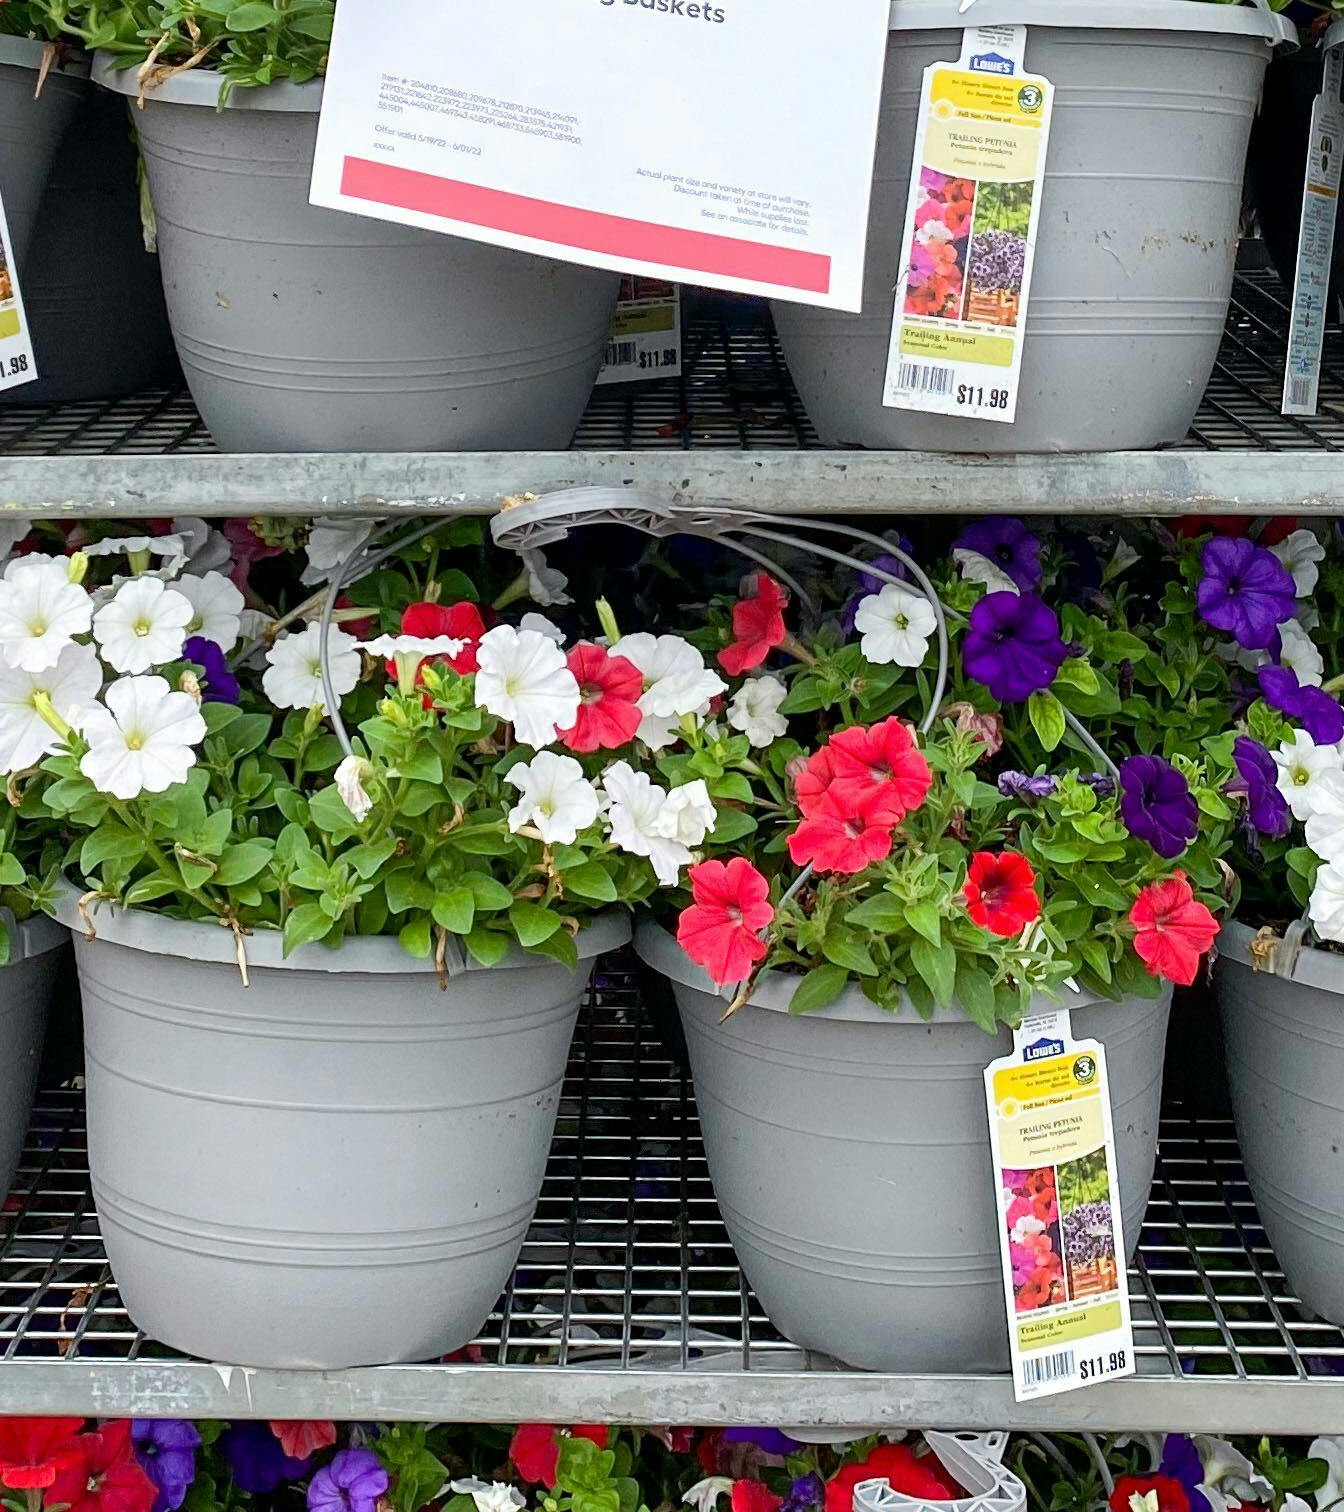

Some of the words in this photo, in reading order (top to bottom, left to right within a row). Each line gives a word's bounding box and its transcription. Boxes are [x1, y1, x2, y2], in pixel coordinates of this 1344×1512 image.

[974, 58, 1010, 73] LOWE'S
[374, 123, 396, 136] Offer
[398, 130, 416, 140] valid
[948, 133, 983, 144] TRAILING
[985, 137, 1017, 148] PETUNIA
[636, 167, 662, 179] Actual
[663, 173, 683, 184] plant
[685, 178, 700, 187] size
[702, 180, 717, 190] and
[673, 184, 707, 198] Discount
[710, 191, 731, 202] taken
[700, 209, 716, 219] See
[717, 213, 728, 221] an
[768, 221, 779, 230] for
[737, 206, 759, 216] While
[761, 210, 792, 224] supplies
[904, 328, 940, 343] Trailing
[943, 333, 976, 346] Annual
[957, 384, 1008, 409] $11.98
[1027, 1043, 1062, 1059] LOWE'S
[1019, 1122, 1052, 1135] TRAILING
[1054, 1116, 1083, 1128] PETUNIA
[1023, 1133, 1048, 1143] Petunia
[1020, 1322, 1054, 1335] Trailing
[1057, 1313, 1087, 1326] Annual
[1080, 1350, 1126, 1379] $11.98
